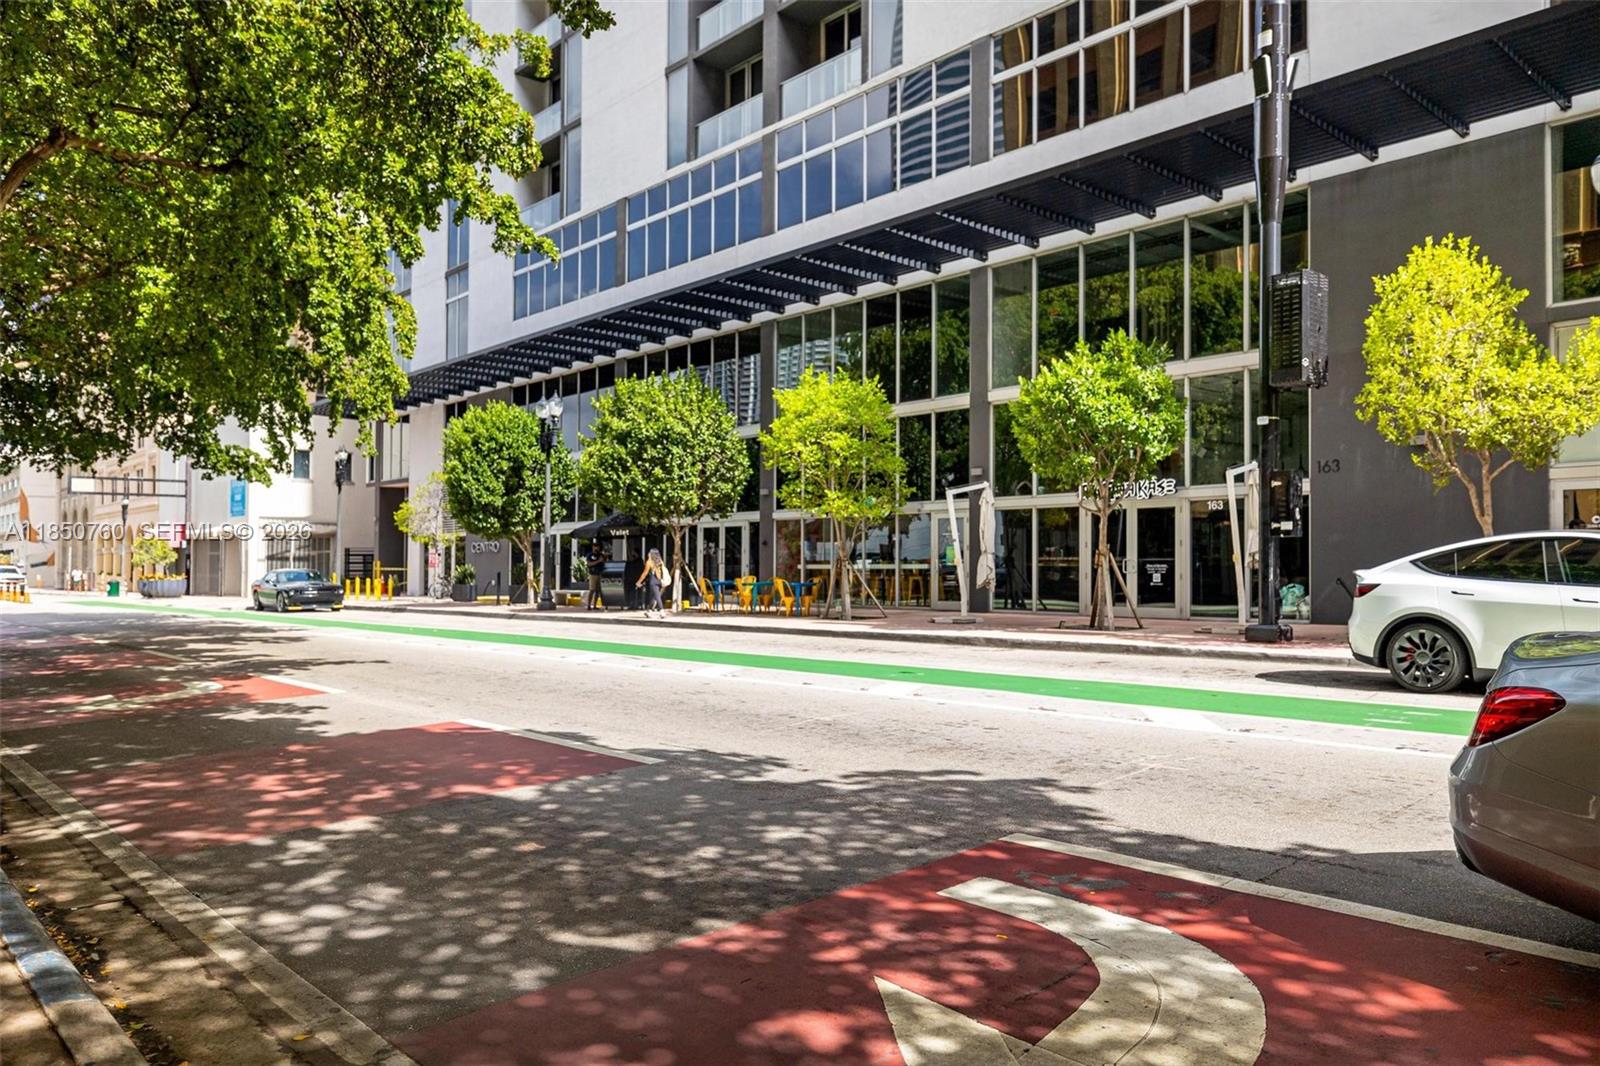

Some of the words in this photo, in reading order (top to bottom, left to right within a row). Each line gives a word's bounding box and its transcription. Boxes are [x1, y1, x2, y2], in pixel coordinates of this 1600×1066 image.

[1317, 458, 1341, 474] 163
[1207, 500, 1224, 510] 163
[470, 540, 500, 554] CENTRO
